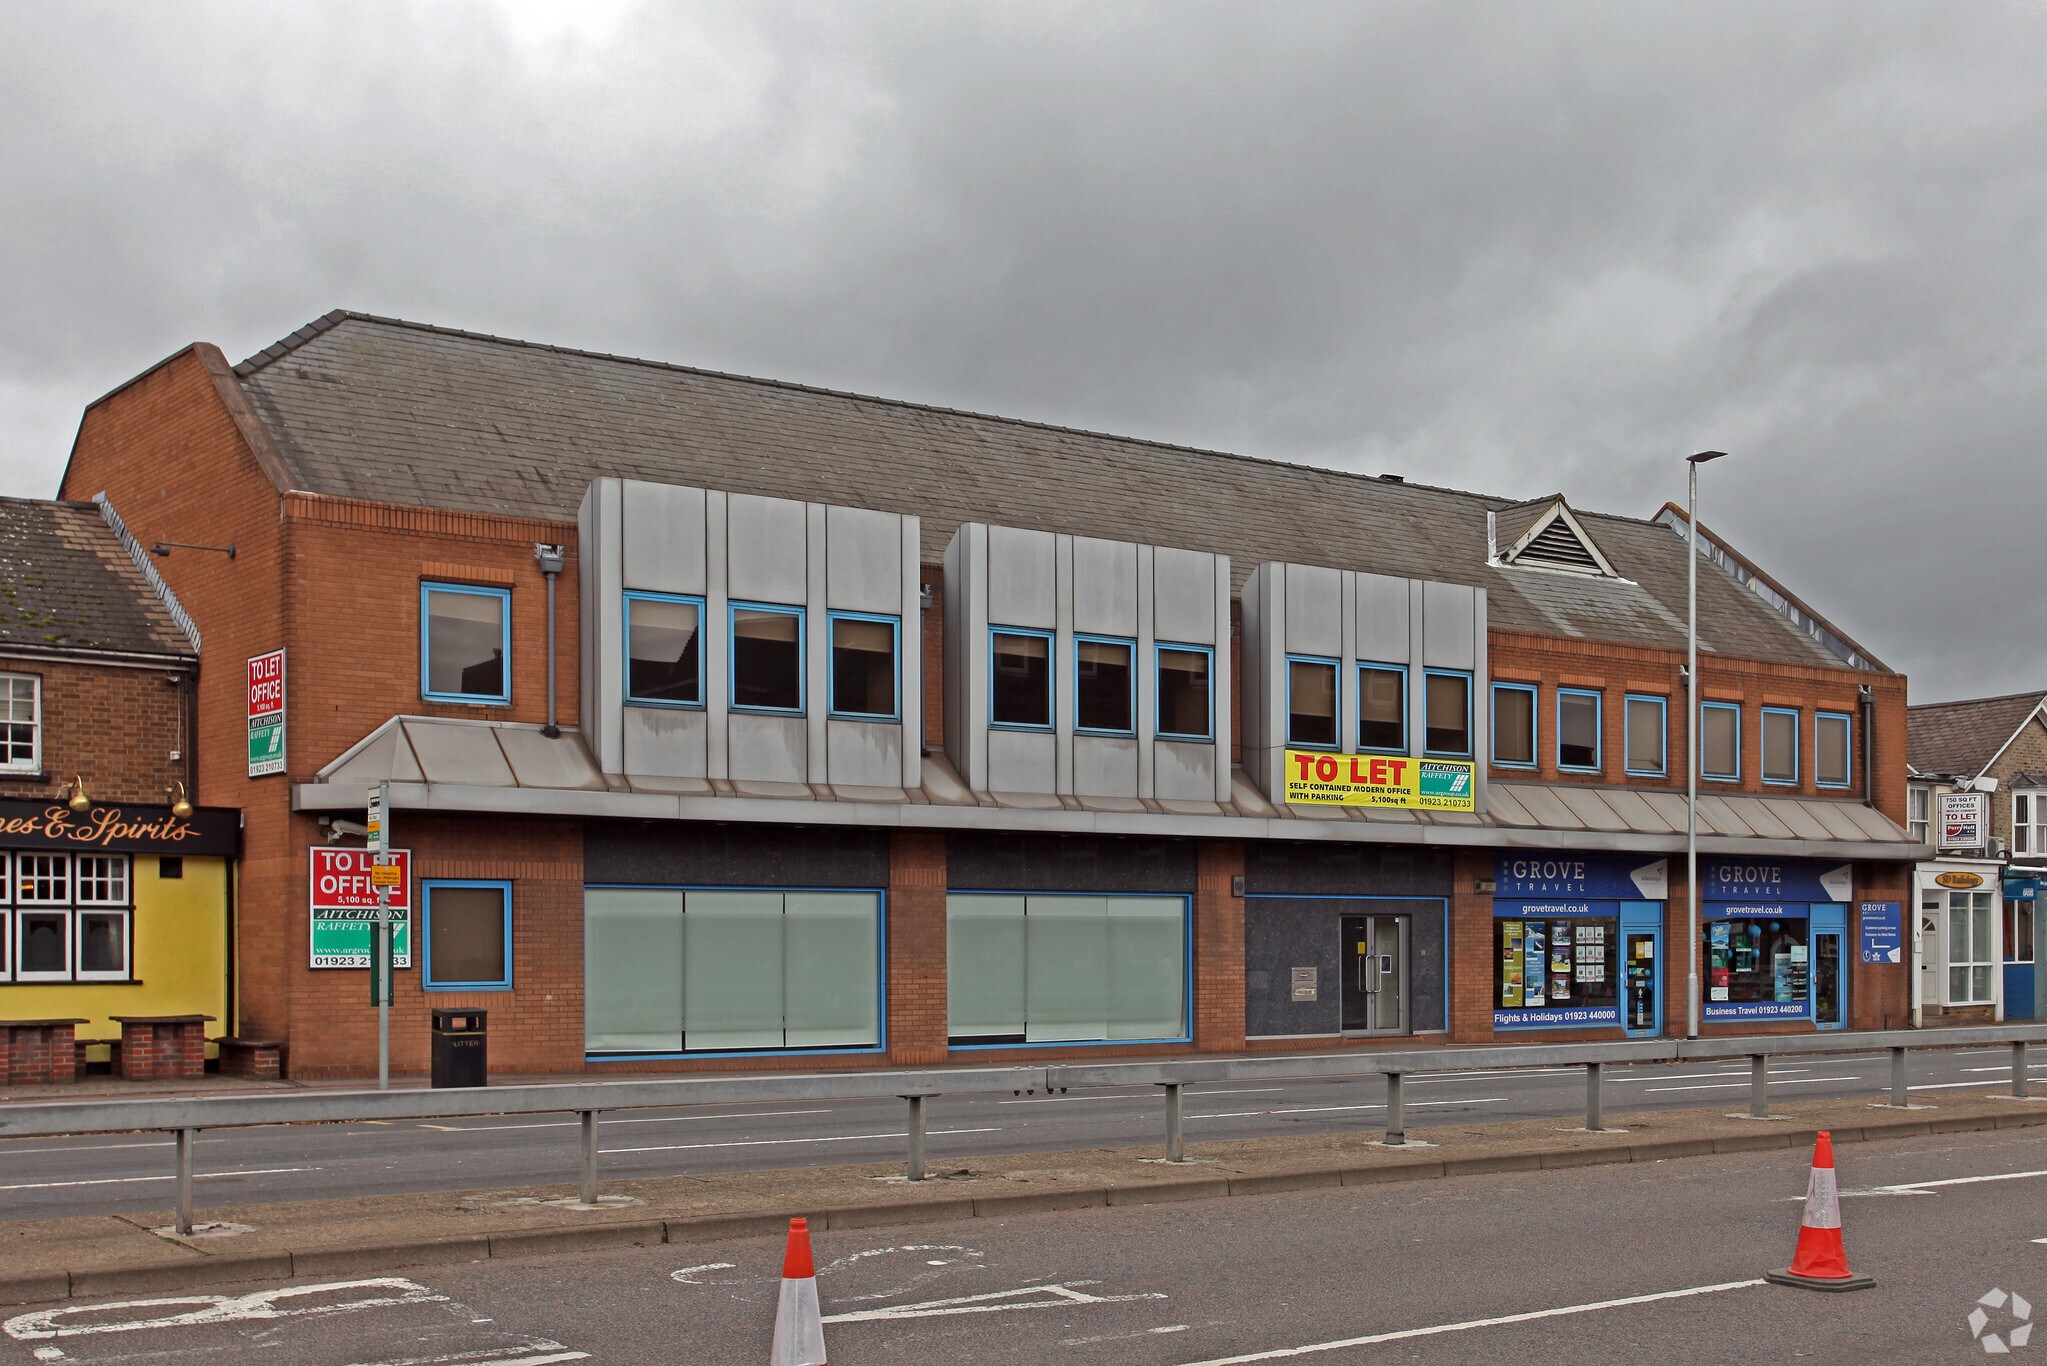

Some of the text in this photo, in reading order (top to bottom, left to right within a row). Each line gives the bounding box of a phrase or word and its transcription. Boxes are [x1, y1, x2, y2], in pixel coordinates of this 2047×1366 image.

[251, 656, 280, 680] TO LET
[251, 680, 280, 703] OFFICE
[250, 714, 282, 728] AITCHISON
[250, 761, 282, 774] 01923 210733
[1295, 754, 1407, 786] TO LET
[1421, 763, 1469, 773] AITCHISON
[1421, 771, 1452, 780] RAFFETY
[1309, 783, 1351, 792] CONTAINED
[1386, 787, 1411, 795] OFFICE
[1311, 793, 1344, 801] PARKING
[1419, 798, 1471, 808] 01923 210733
[68, 808, 201, 846] Spirits
[321, 852, 352, 871] TO
[1513, 861, 1585, 880] GROVE
[1719, 866, 1781, 883] GROVE
[1517, 883, 1585, 892] TRAVEL
[1722, 886, 1781, 895] TRAVEL
[338, 896, 360, 904] 5,100
[1522, 904, 1588, 915] grovetravel.co.uk
[1725, 906, 1783, 915] grovetravel.co.uk
[315, 957, 355, 966] 01923
[1706, 1005, 1803, 1016] Business Travel 01923 440200
[1494, 1010, 1616, 1024] Flights & Holidays 01923 440000
